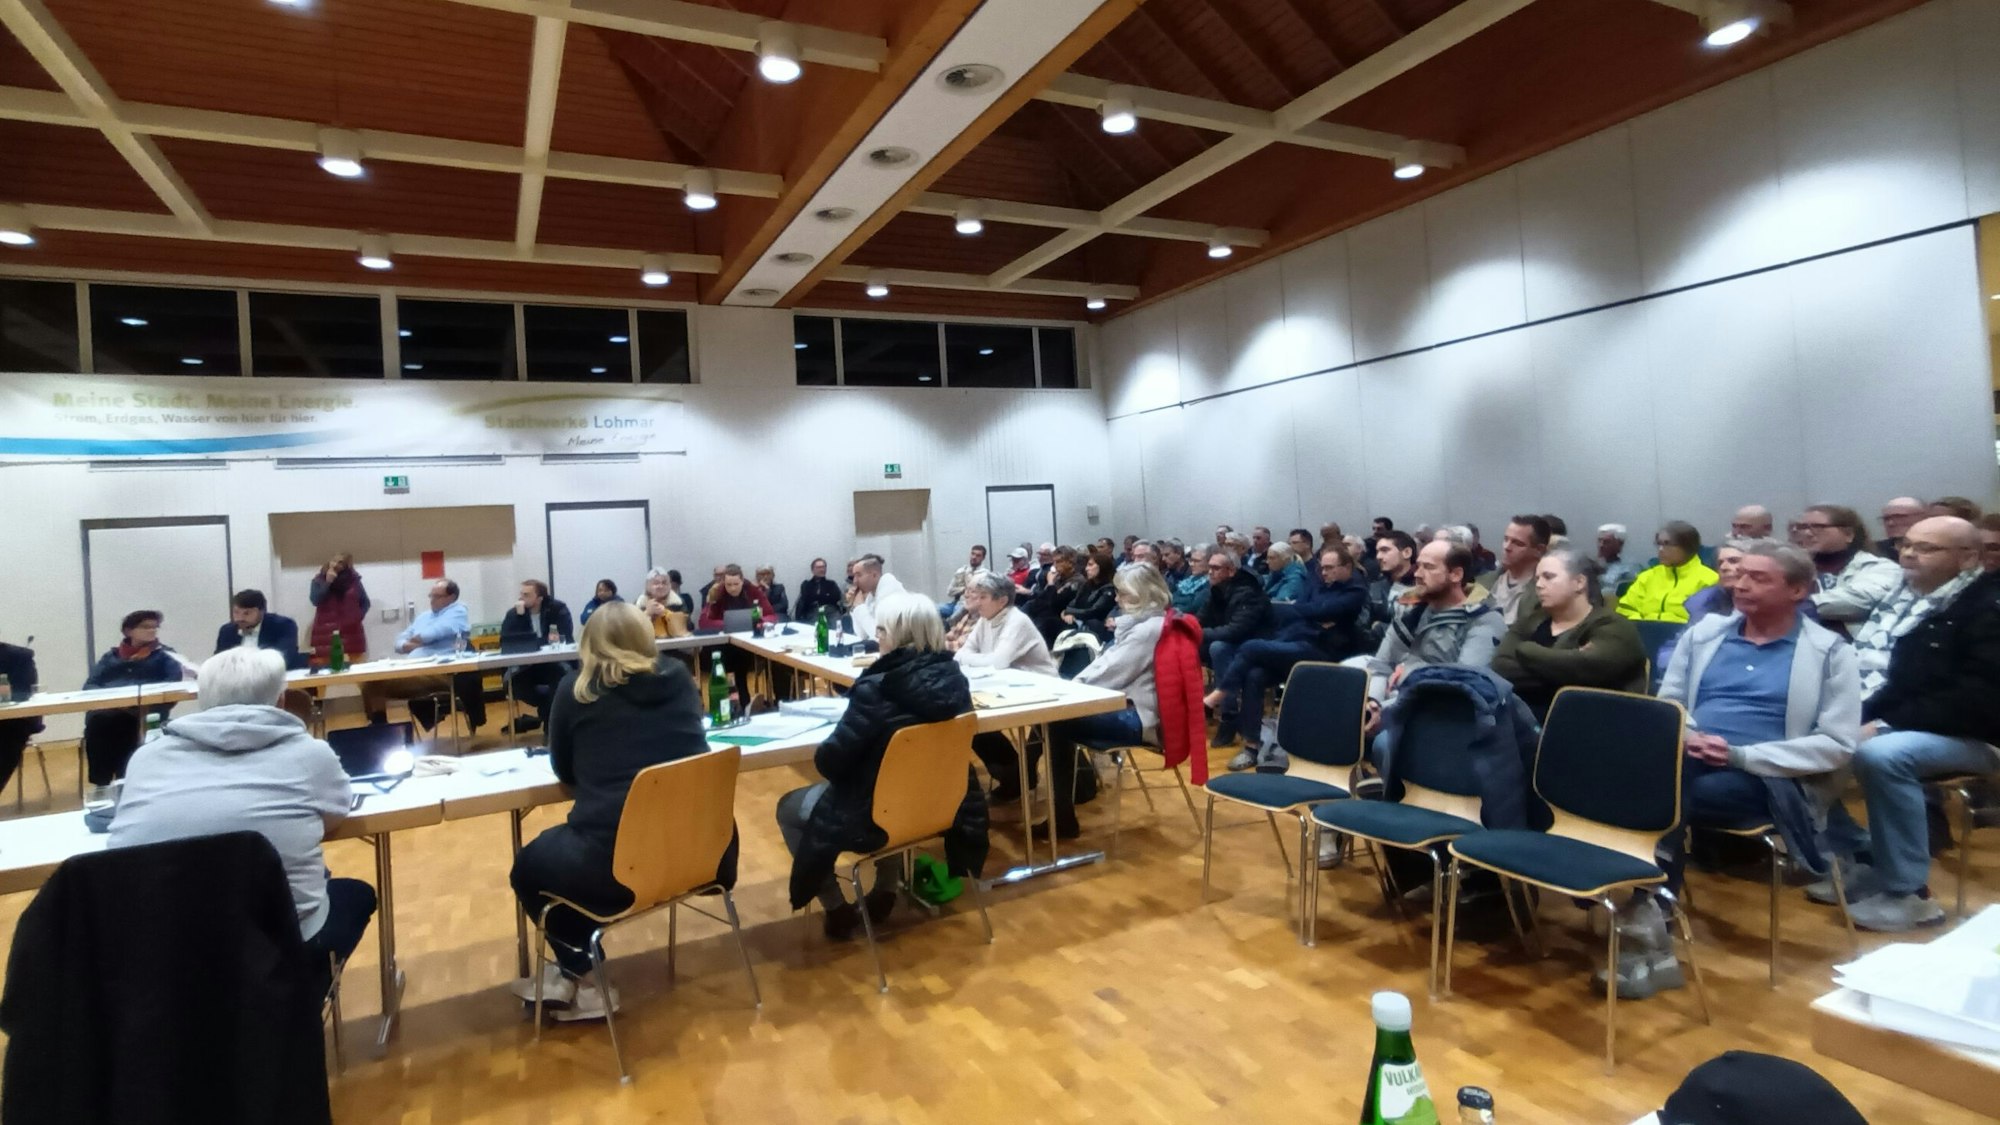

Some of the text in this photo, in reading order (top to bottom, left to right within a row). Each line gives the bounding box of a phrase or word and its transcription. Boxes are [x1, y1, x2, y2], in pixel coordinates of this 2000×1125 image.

[53, 392, 125, 408] Meine
[54, 413, 102, 424] Strom,
[105, 413, 159, 425] Erdgas,
[161, 413, 210, 423] Wasser
[215, 414, 238, 423] von
[241, 412, 266, 423] hier
[269, 412, 287, 423] für
[484, 415, 655, 429] Stadtwerke Lohmar
